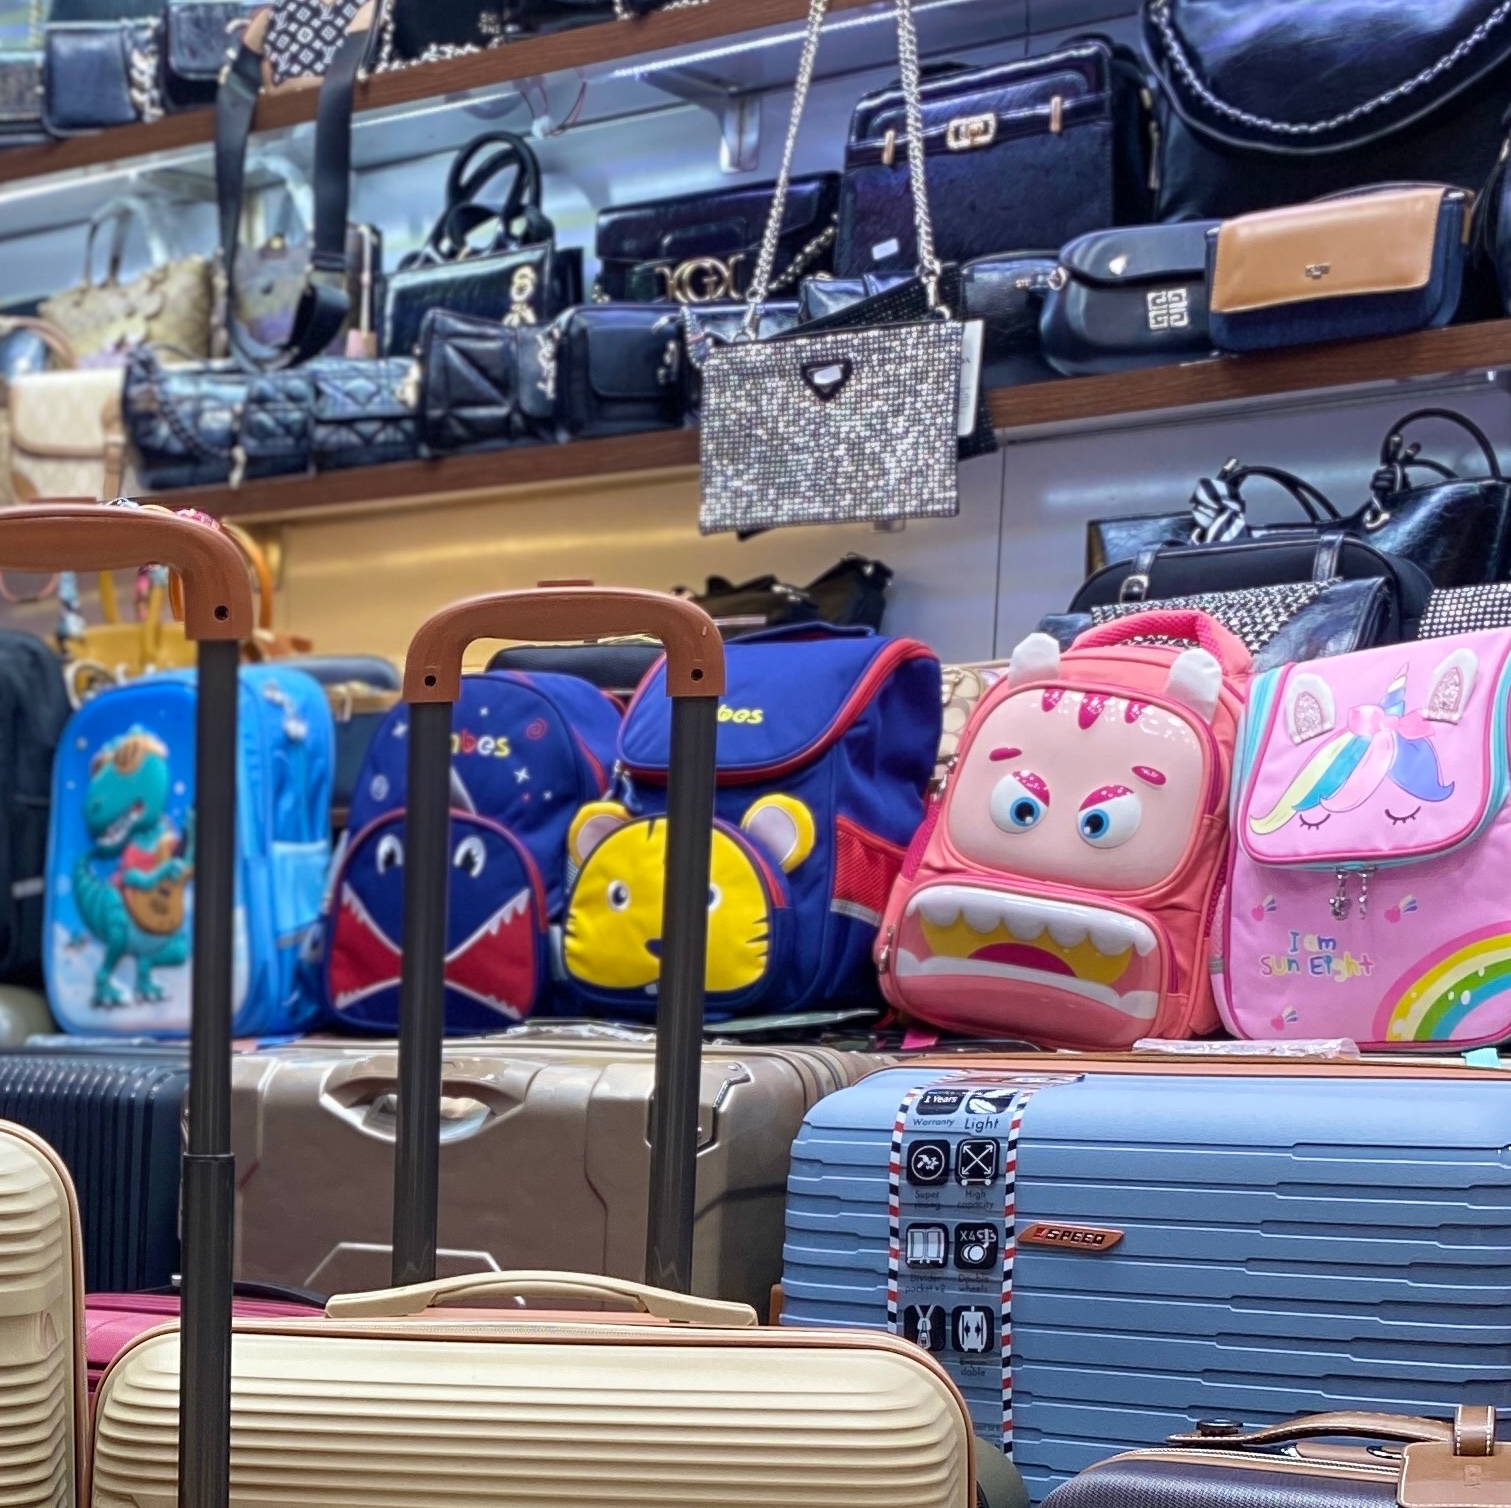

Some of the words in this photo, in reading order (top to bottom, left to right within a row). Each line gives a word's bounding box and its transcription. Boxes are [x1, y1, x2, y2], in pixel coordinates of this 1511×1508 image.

[1289, 930, 1300, 953] I
[1303, 933, 1337, 953] am
[912, 1118, 955, 1127] Warranty
[964, 1116, 999, 1133] Light
